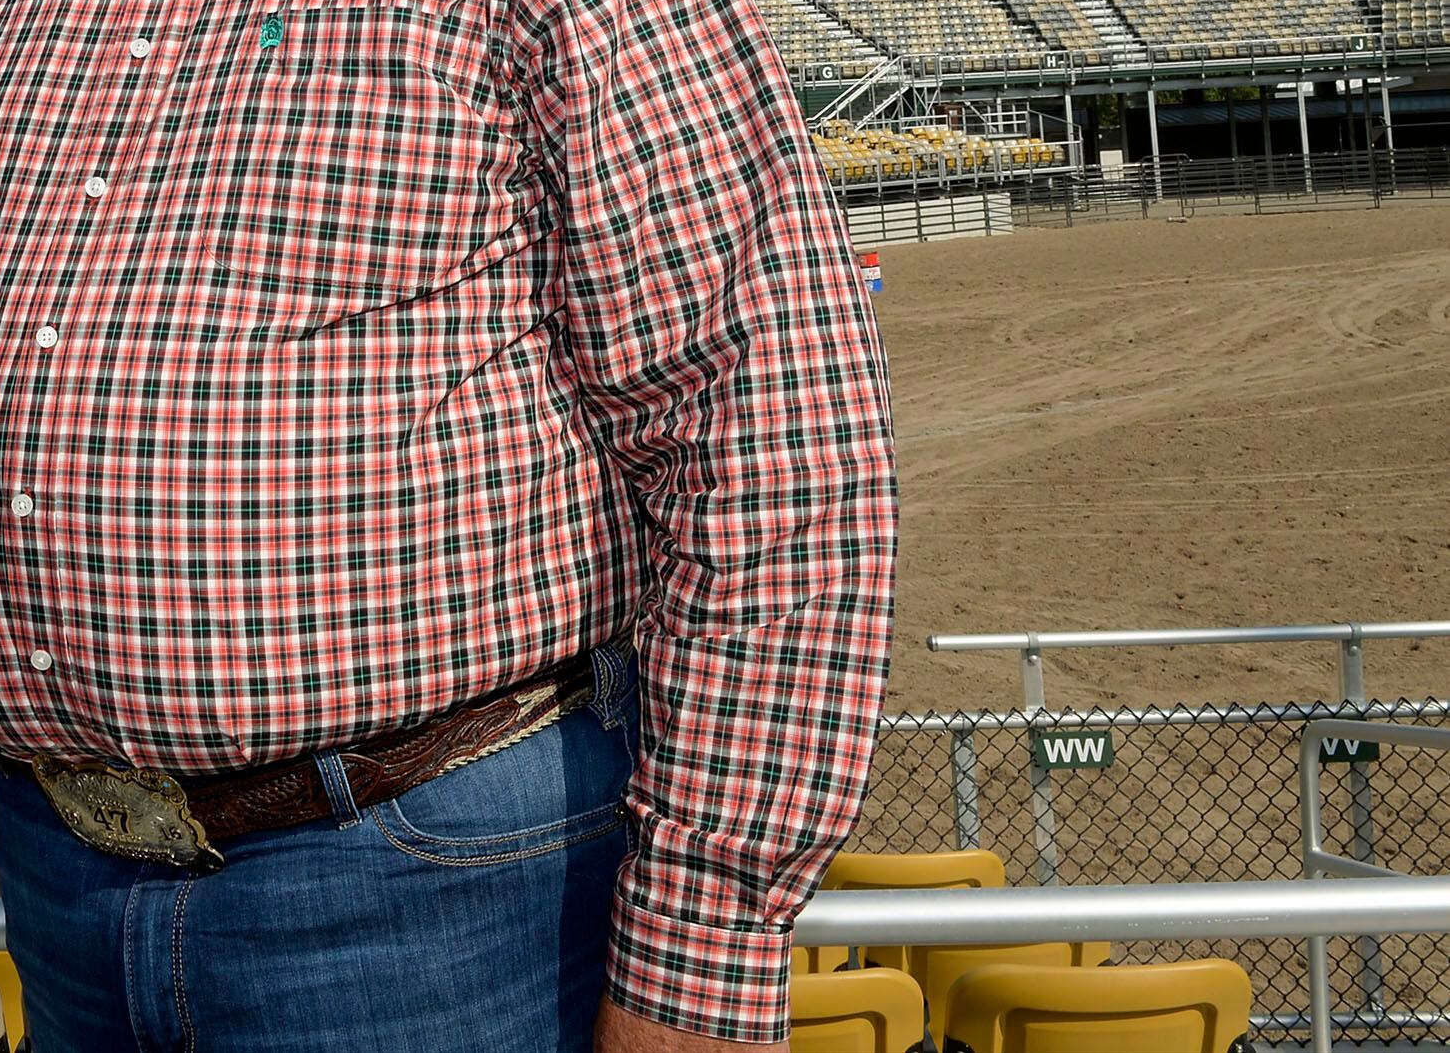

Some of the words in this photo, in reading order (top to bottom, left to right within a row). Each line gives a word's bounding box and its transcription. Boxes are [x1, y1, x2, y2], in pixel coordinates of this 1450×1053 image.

[1355, 38, 1364, 50] J
[1047, 55, 1056, 68] H
[822, 66, 833, 79] G
[1043, 737, 1105, 763] WW
